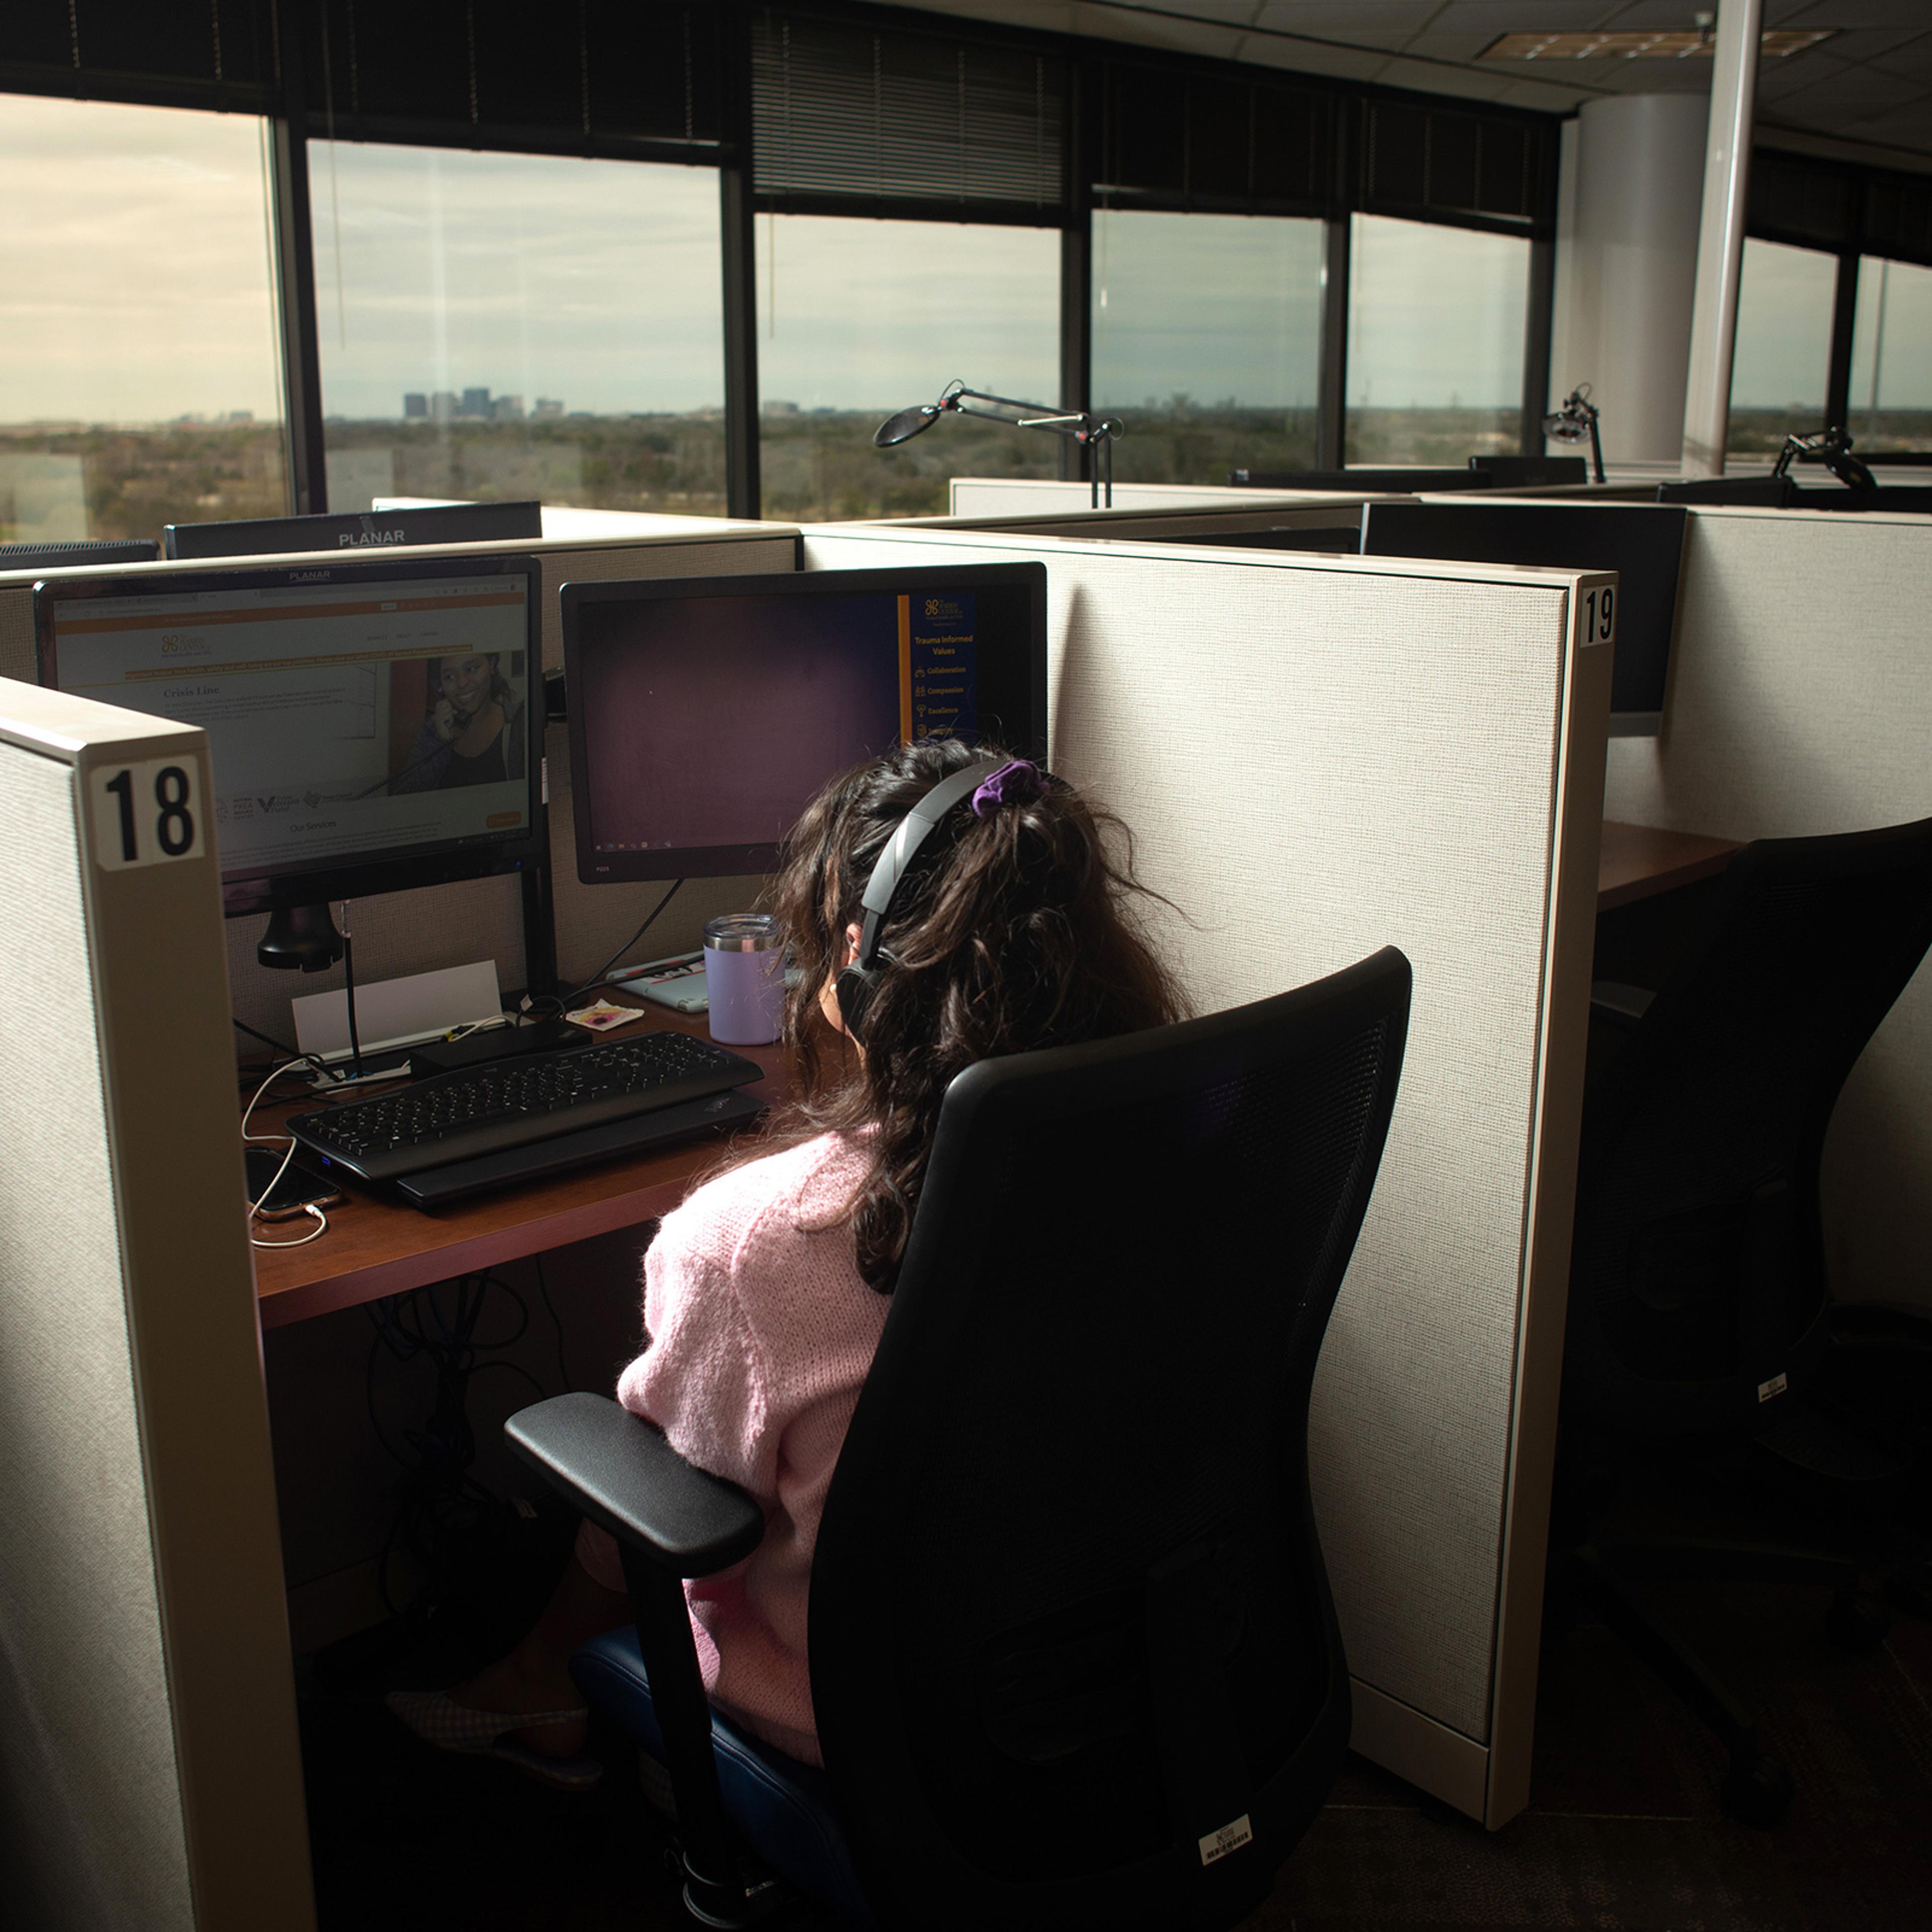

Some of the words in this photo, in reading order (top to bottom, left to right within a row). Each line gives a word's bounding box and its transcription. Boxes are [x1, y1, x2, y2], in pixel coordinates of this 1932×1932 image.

[339, 530, 405, 546] PLANAR
[290, 571, 330, 580] PLANAR
[1587, 588, 1613, 643] 19
[942, 634, 974, 643] Informed
[932, 647, 956, 656] Values
[927, 667, 967, 675] Collaboration
[164, 687, 194, 698] Crisis
[197, 686, 220, 695] Line
[927, 687, 964, 695] Compassion
[928, 706, 958, 714] Excellence
[106, 766, 194, 861] 18
[290, 824, 304, 833] Our
[306, 820, 337, 831] Services
